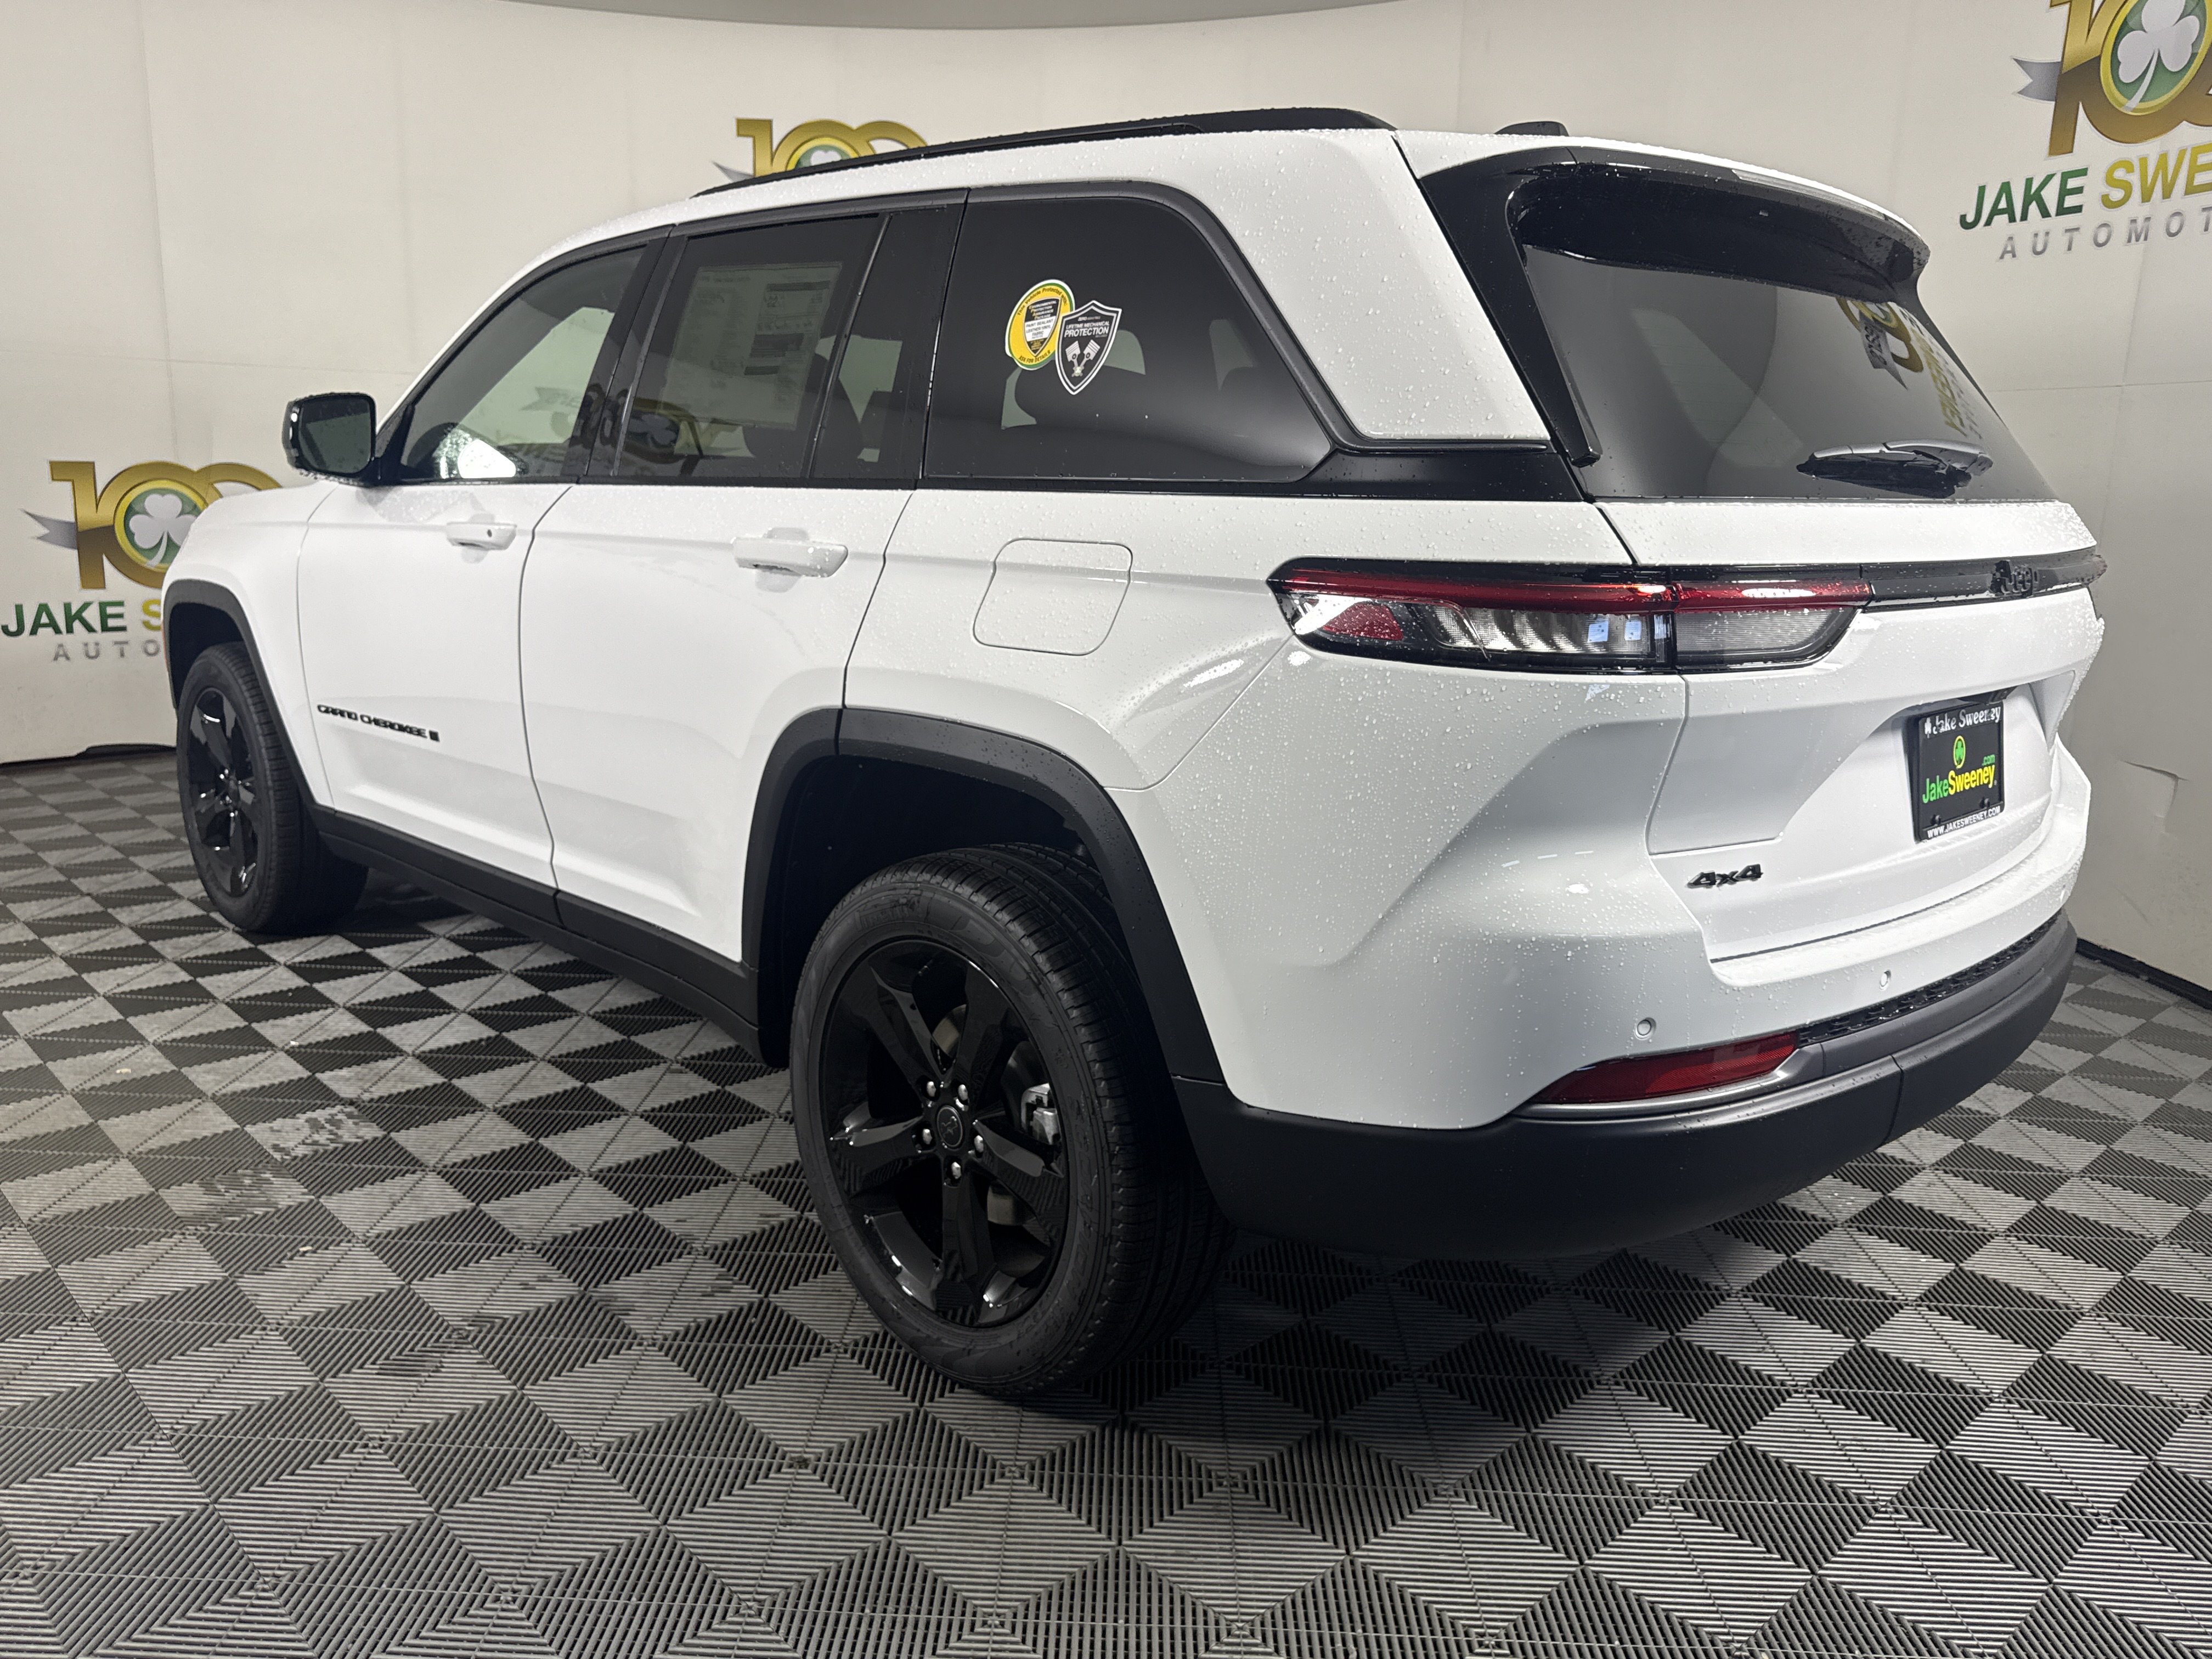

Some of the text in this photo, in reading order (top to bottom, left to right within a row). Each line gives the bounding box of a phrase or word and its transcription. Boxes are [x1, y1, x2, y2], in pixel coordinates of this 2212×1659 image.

[1959, 168, 2089, 230] JAKE
[1064, 326, 1109, 338] PROTECTION
[1, 600, 127, 636] JAKE
[317, 704, 427, 738] GRAND CHEROKEE
[1922, 765, 1995, 803] JakeSweeney
